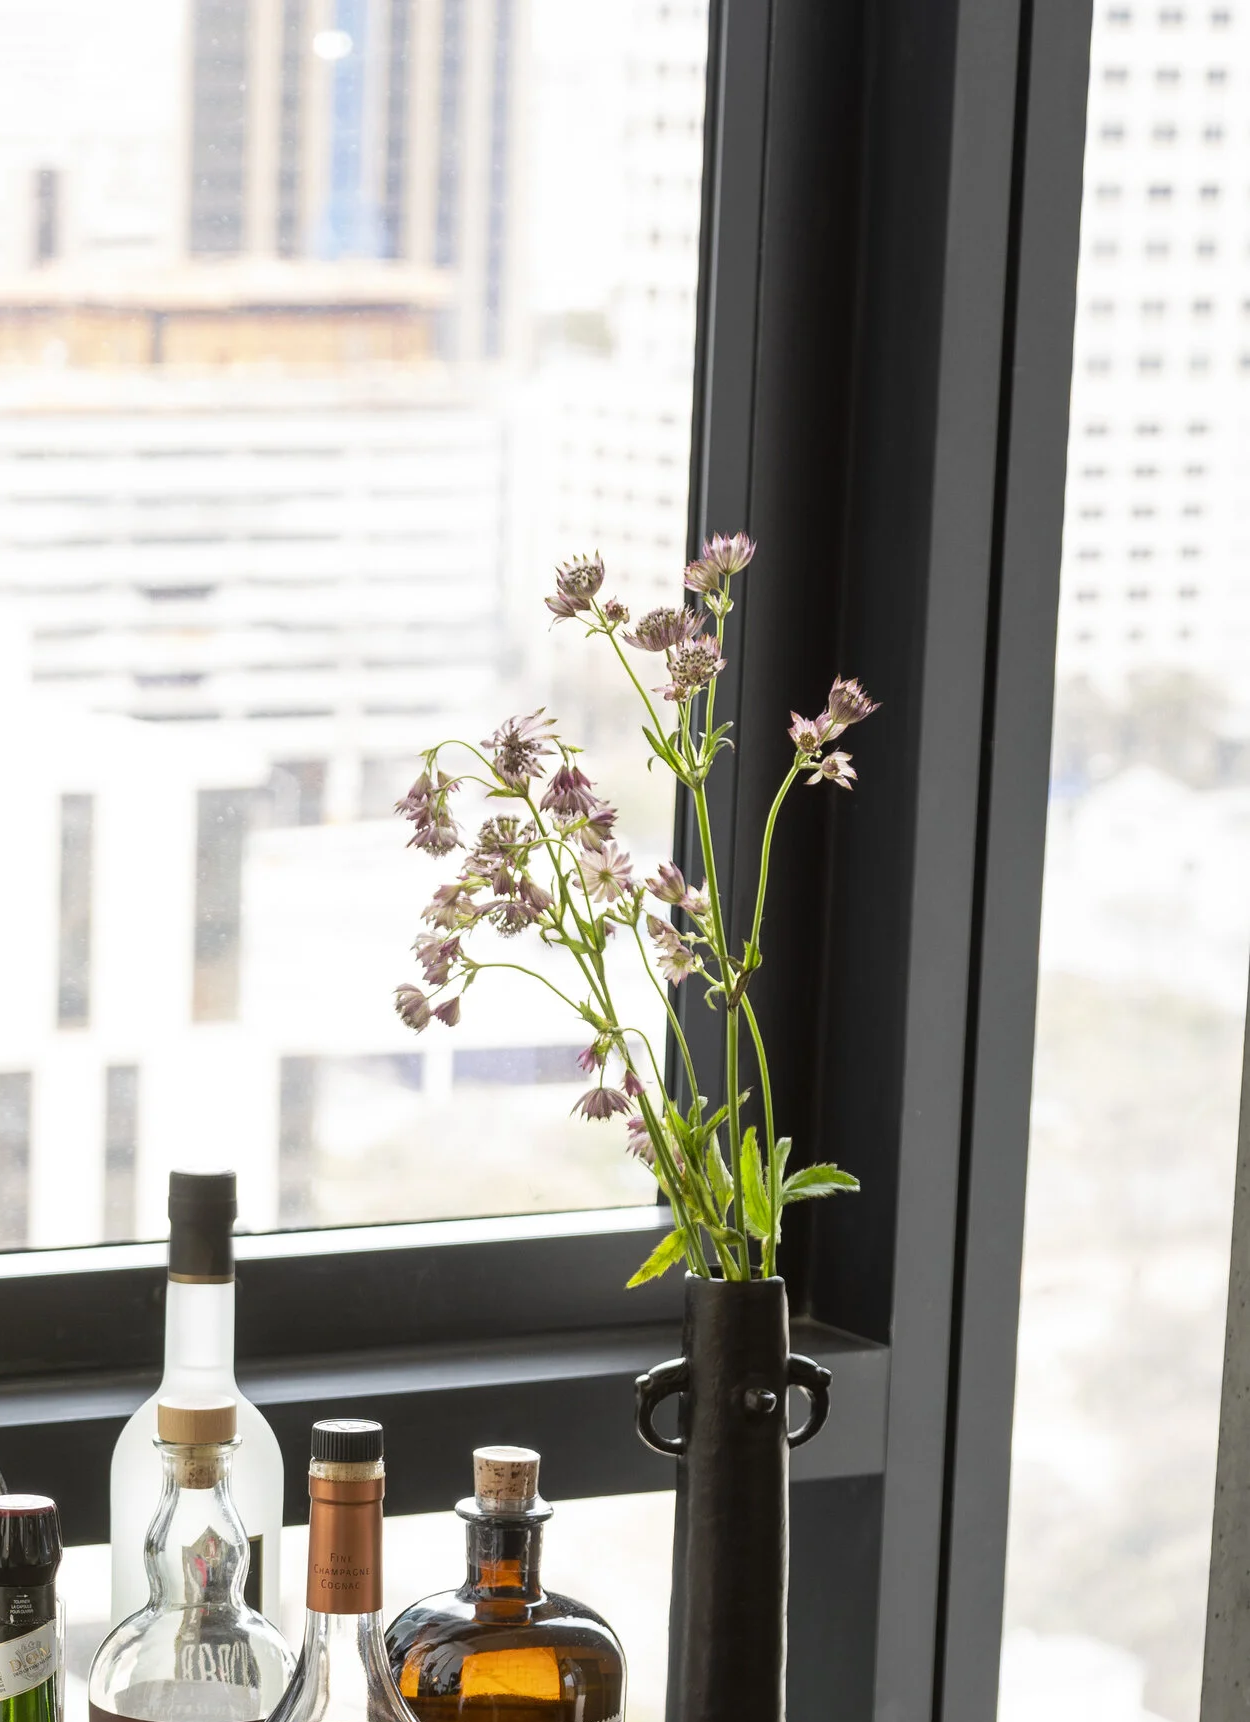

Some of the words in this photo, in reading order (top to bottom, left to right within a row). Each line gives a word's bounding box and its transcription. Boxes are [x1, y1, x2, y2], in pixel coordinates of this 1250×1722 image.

[330, 1553, 353, 1563] FINE
[314, 1564, 370, 1576] CHAMPAGNE
[321, 1579, 360, 1590] COGNAC
